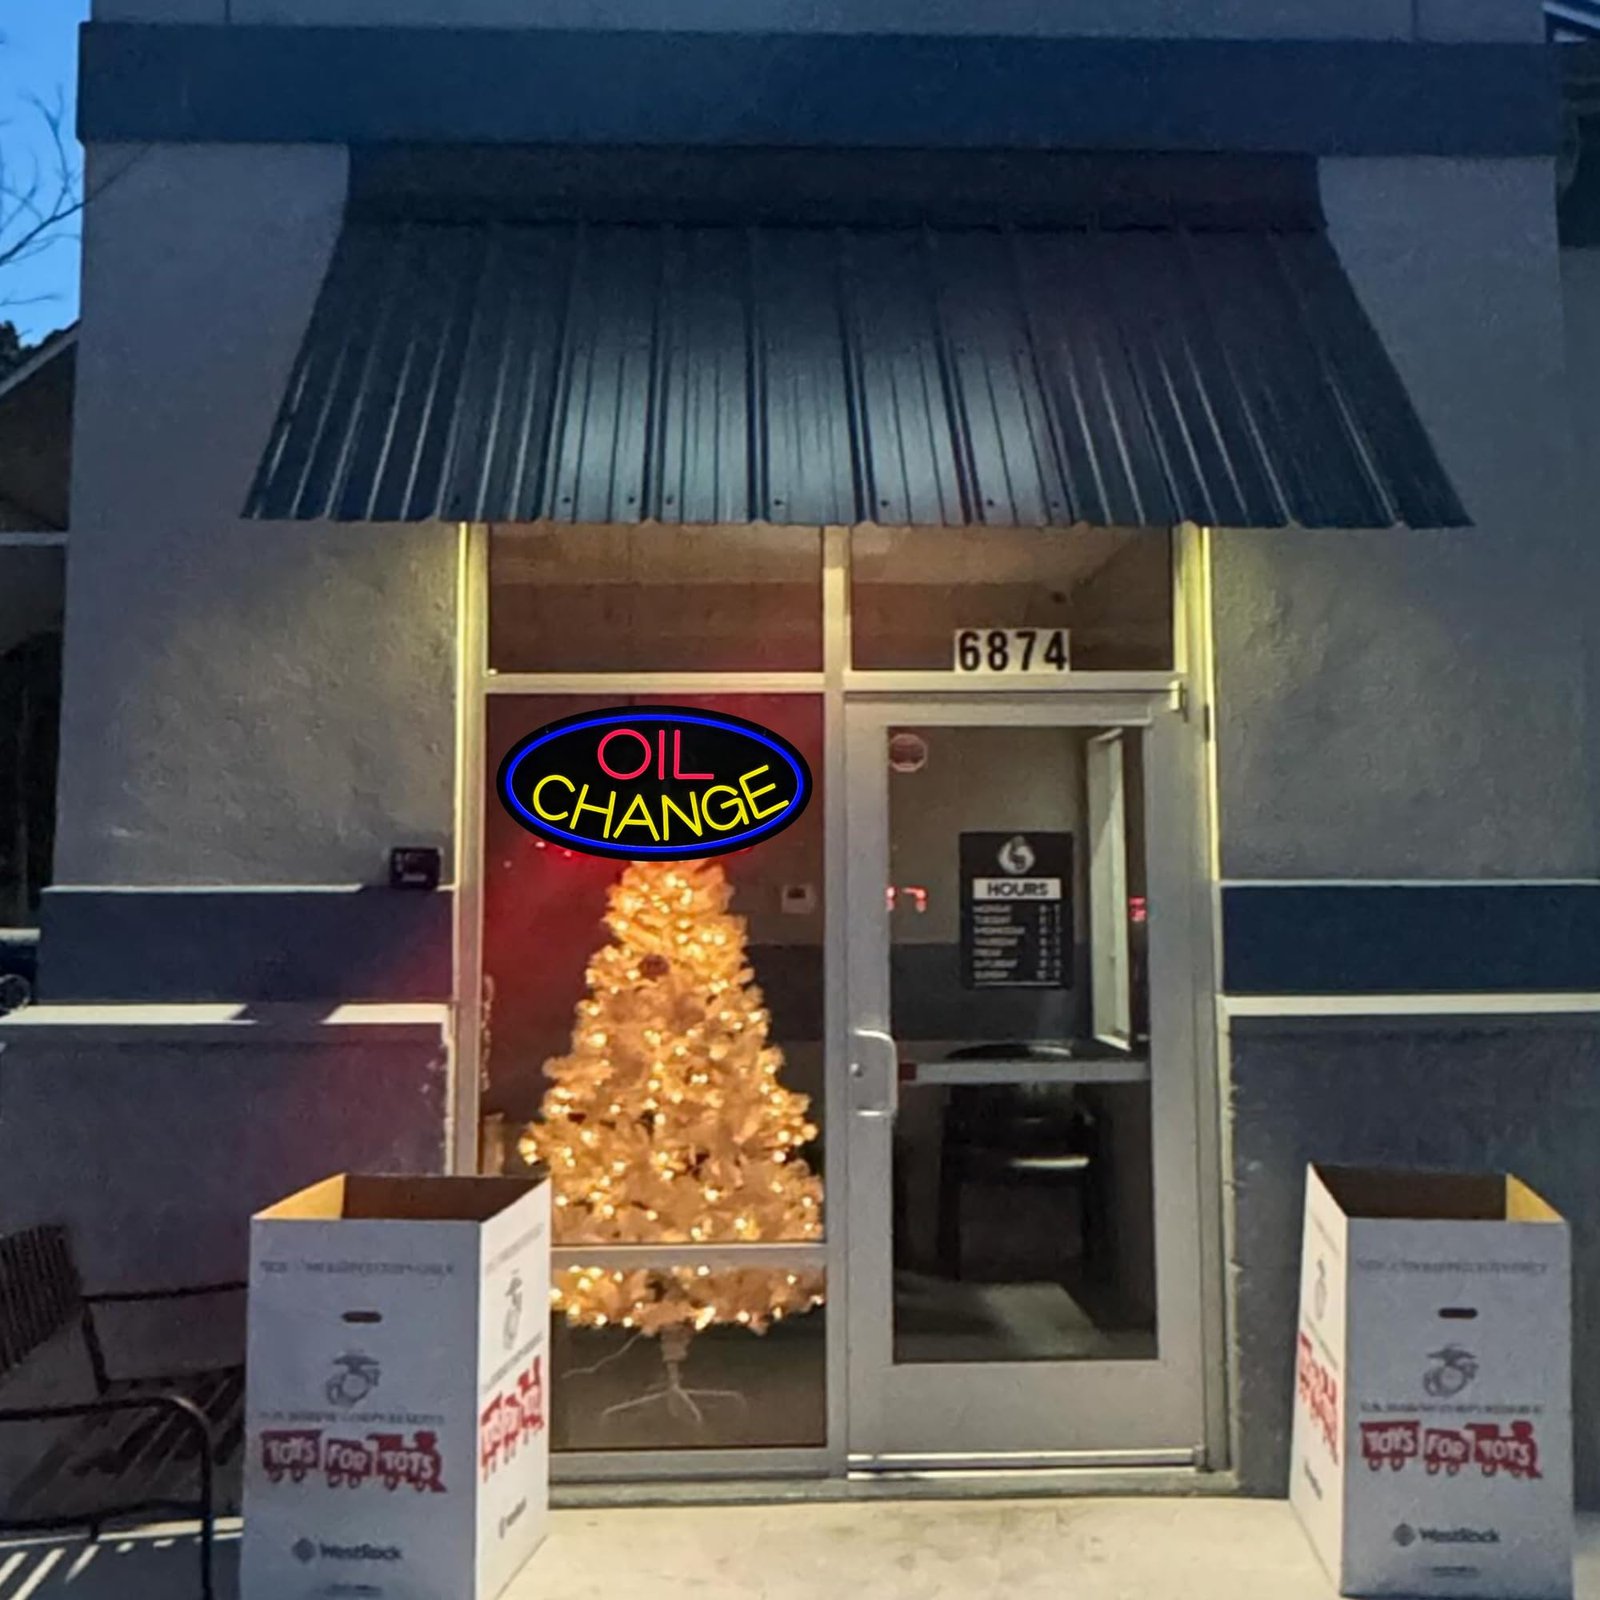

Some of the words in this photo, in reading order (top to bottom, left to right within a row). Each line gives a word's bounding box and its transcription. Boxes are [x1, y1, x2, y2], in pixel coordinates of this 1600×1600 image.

[957, 631, 1067, 671] 6874
[597, 728, 714, 780] OIL
[532, 764, 790, 841] CHANGE
[987, 882, 1048, 897] HOURS
[267, 1437, 316, 1464] TOYS
[328, 1444, 368, 1471] FOR
[383, 1452, 433, 1480] TOTS
[1365, 1427, 1415, 1454] TOYS
[1425, 1434, 1463, 1460] FOR
[1478, 1441, 1530, 1467] TOTS
